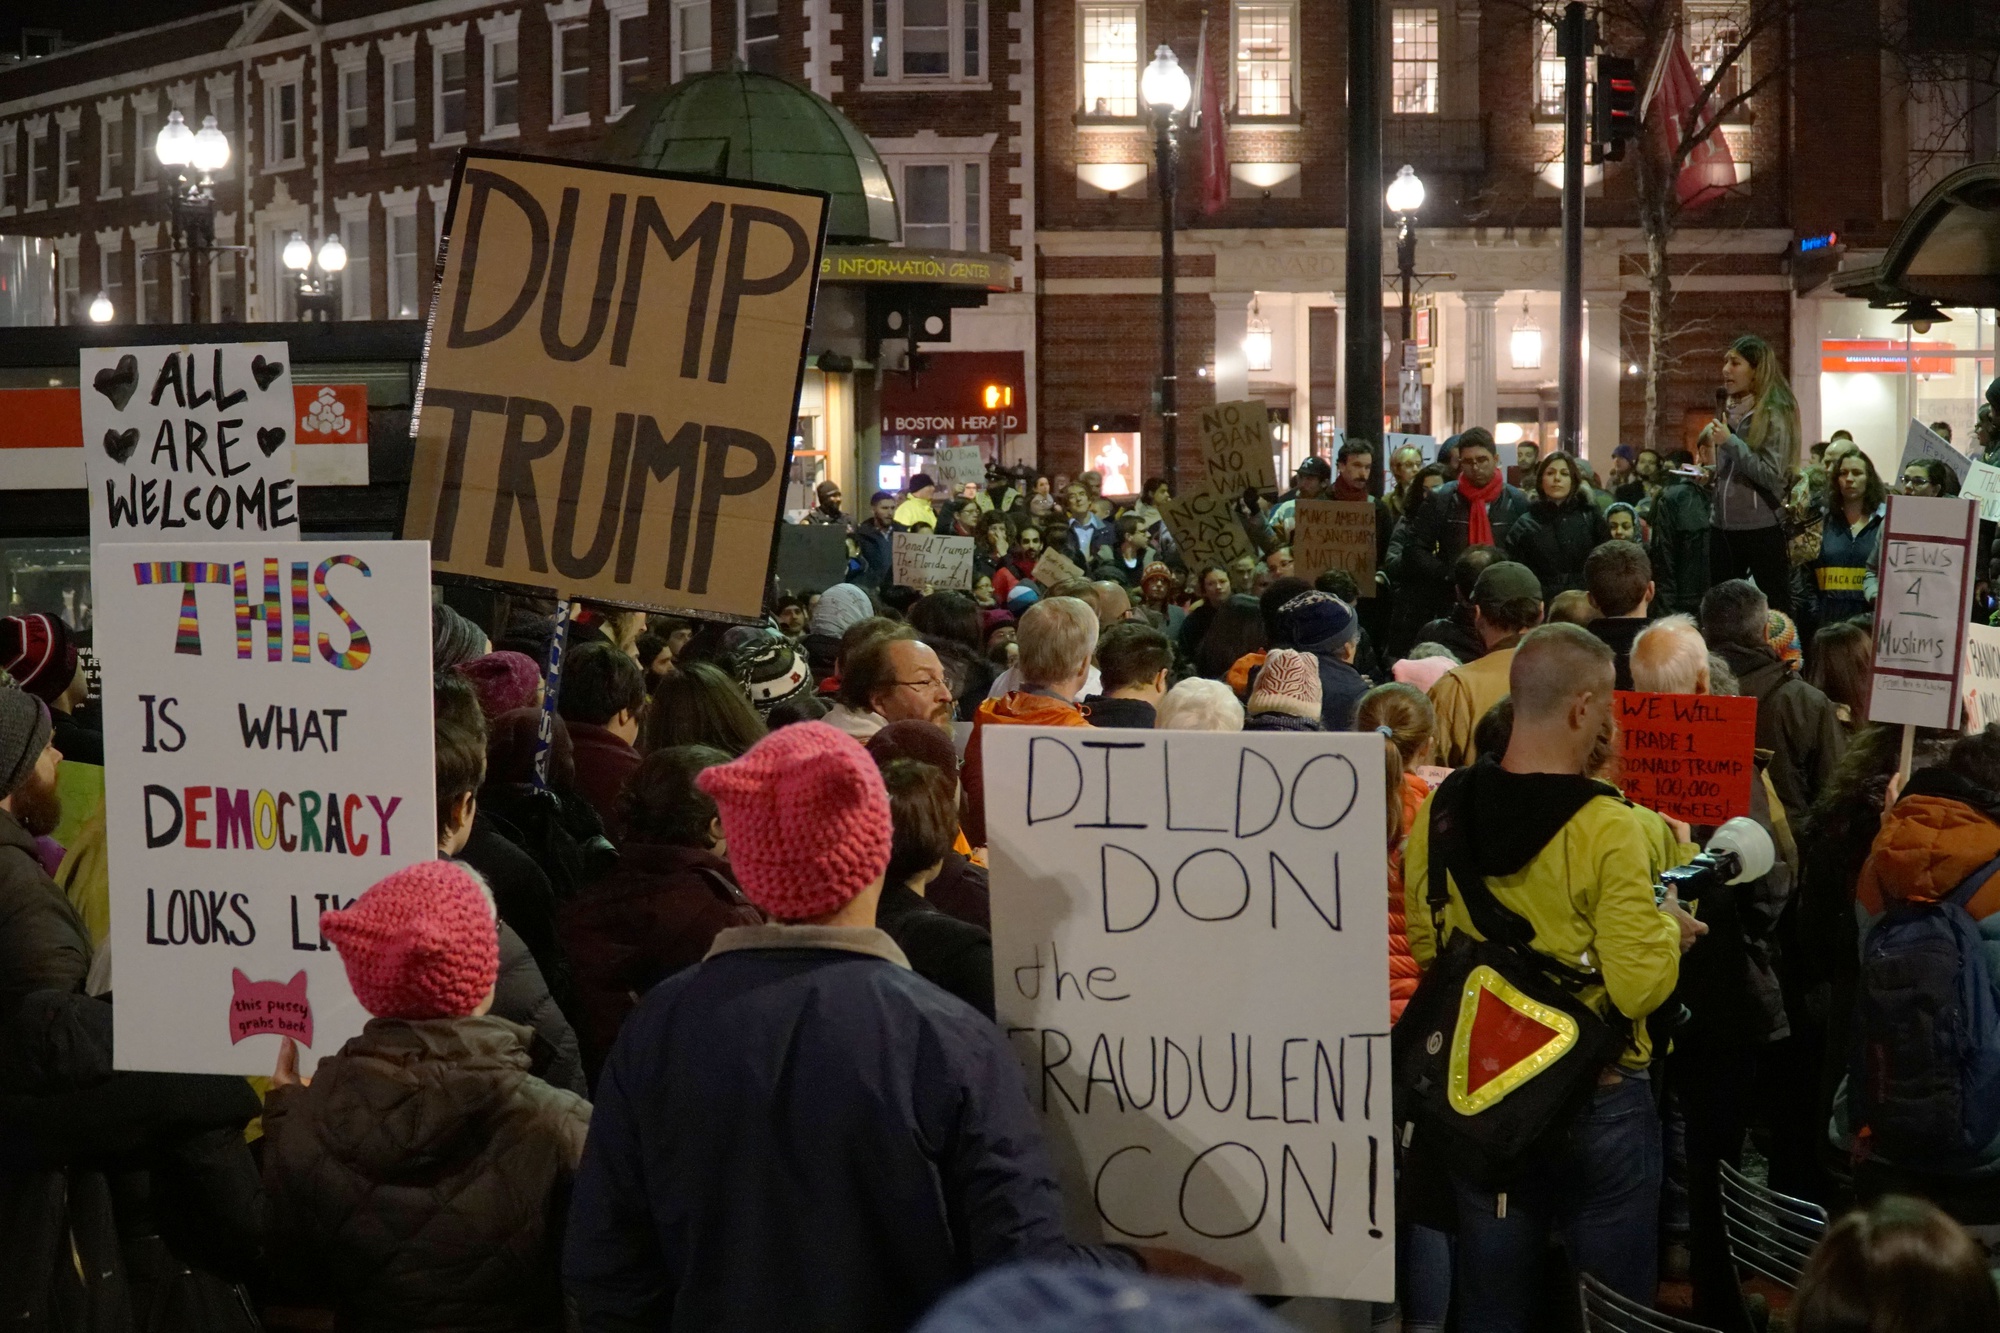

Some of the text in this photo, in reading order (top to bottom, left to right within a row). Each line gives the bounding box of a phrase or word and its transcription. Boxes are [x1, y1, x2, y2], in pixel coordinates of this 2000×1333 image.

[448, 167, 811, 385] DUMP
[838, 257, 945, 277] INFORMATION
[950, 262, 991, 279] CENTER
[149, 348, 248, 411] ALL
[895, 416, 955, 431] BOSTON
[1202, 405, 1240, 434] NO
[150, 418, 252, 478] ARE
[1211, 420, 1263, 452] BAN
[935, 449, 954, 462] NO
[1207, 450, 1244, 478] NO
[938, 465, 957, 481] NO
[105, 473, 298, 532] WELCOME
[421, 387, 778, 596] TRUMP
[1174, 501, 1233, 552] BAN
[1298, 507, 1331, 525] MAKE
[896, 533, 935, 554] Donald
[1192, 530, 1235, 563] NO
[1302, 526, 1312, 542] A
[894, 551, 963, 573] The Florida of
[1888, 542, 1953, 568] JEWS
[898, 567, 969, 588] Presidents!
[1906, 576, 1923, 607] 4
[133, 554, 372, 671] THIS
[1877, 619, 1945, 659] Muslims
[138, 694, 348, 754] IS WHAT
[1621, 696, 1727, 723] WE WILL
[1622, 729, 1697, 753] TRADE 1
[1683, 759, 1743, 777] TRUMP
[1027, 735, 1359, 839] DILDO
[1655, 777, 1721, 798] 100,000
[143, 784, 402, 857] DEMOCRACY
[1101, 843, 1343, 933] DON
[146, 888, 256, 946] LOOKS
[1013, 941, 1131, 1002] the
[235, 998, 309, 1020] this pussy
[278, 1017, 306, 1034] back
[1094, 1134, 1384, 1244] CON!
